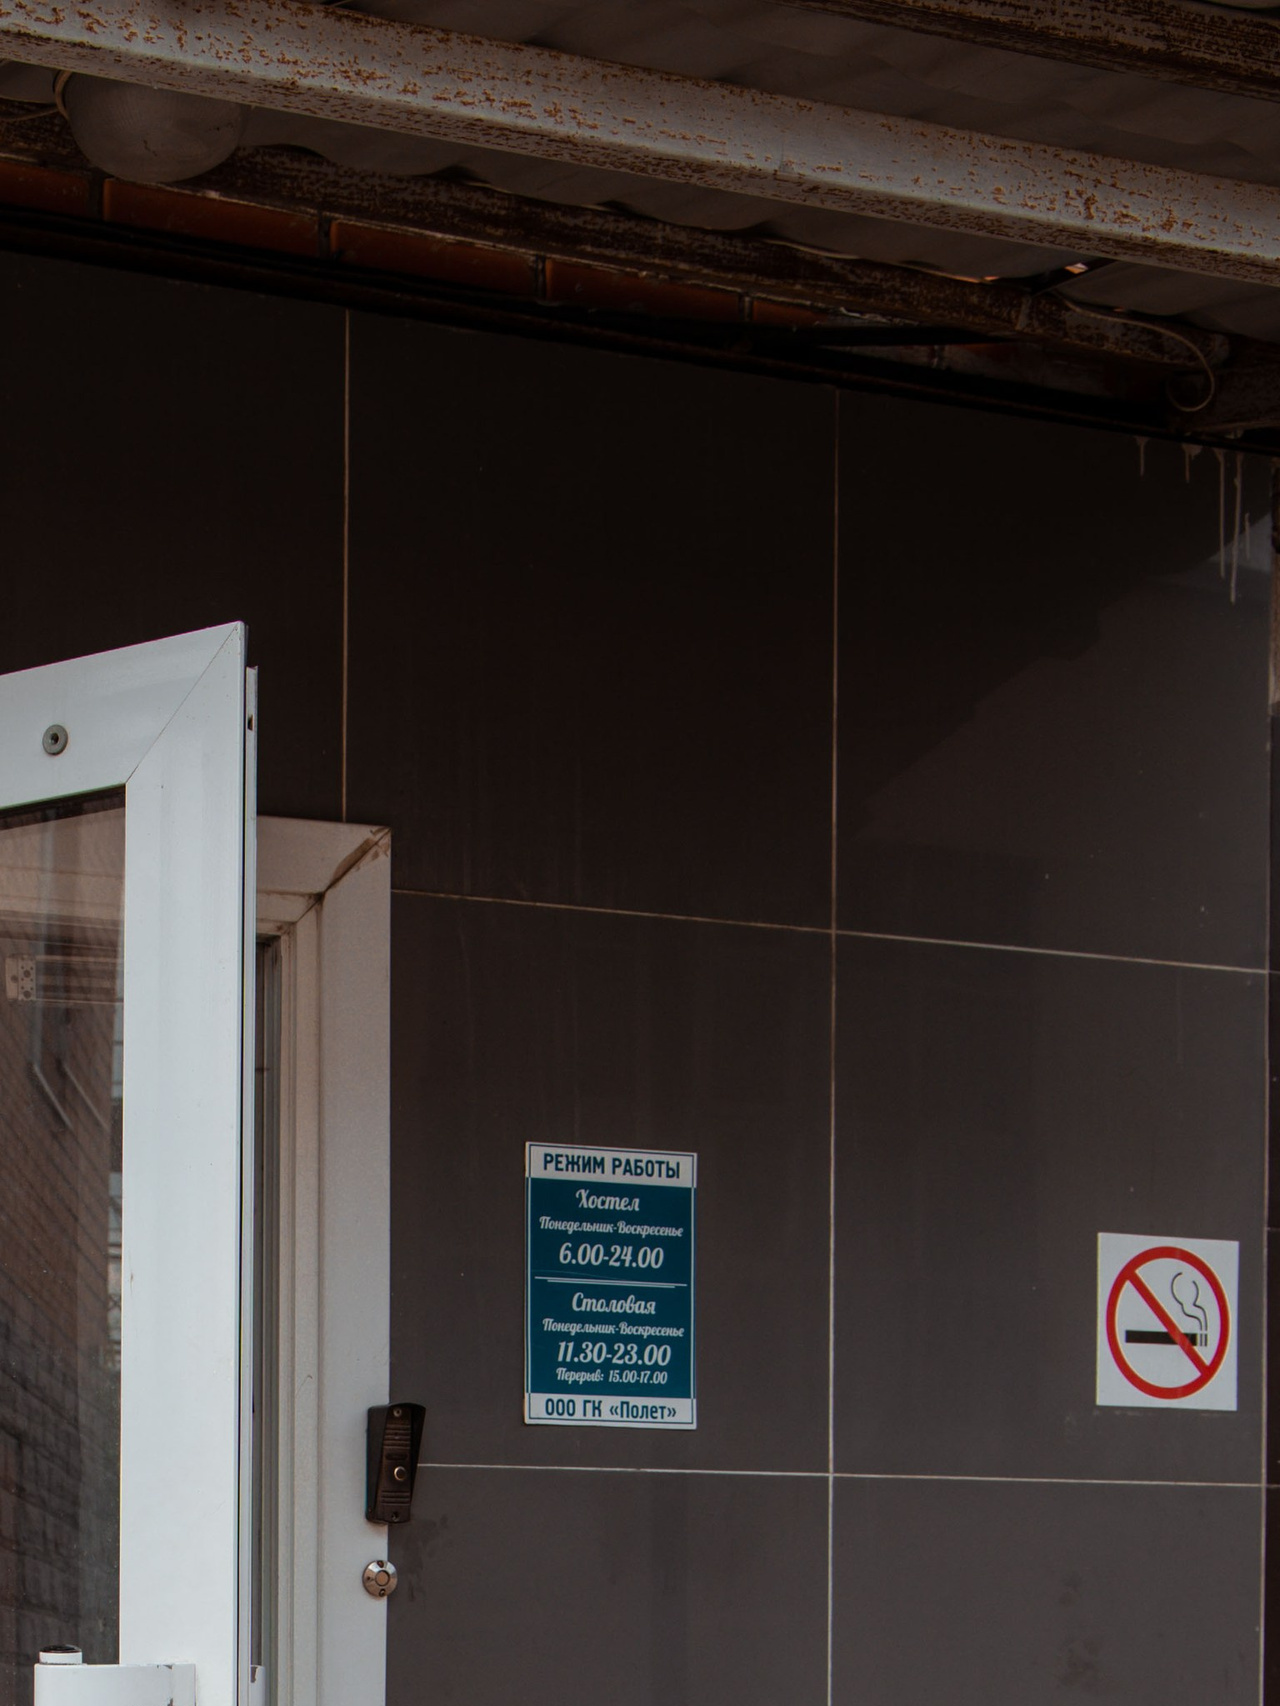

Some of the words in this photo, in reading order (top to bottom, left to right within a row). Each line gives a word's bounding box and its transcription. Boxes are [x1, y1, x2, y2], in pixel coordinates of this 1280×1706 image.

[543, 1153, 605, 1174] РЕЖИМ
[612, 1157, 680, 1179] РАБОТЫ
[575, 1189, 640, 1212] Хостел
[539, 1216, 684, 1239] Понедельник-Воскресенье
[559, 1243, 664, 1269] 6.00-24.00
[572, 1292, 656, 1315] Столовая
[542, 1318, 684, 1339] Понедельник-Воскресенье
[557, 1341, 671, 1366] 11.30-23.00
[556, 1367, 604, 1385] Перерыв:
[609, 1370, 668, 1384] 15.00-17.00
[545, 1398, 576, 1416] ООО
[583, 1400, 603, 1418] ГК
[609, 1401, 677, 1420] «Полет»
